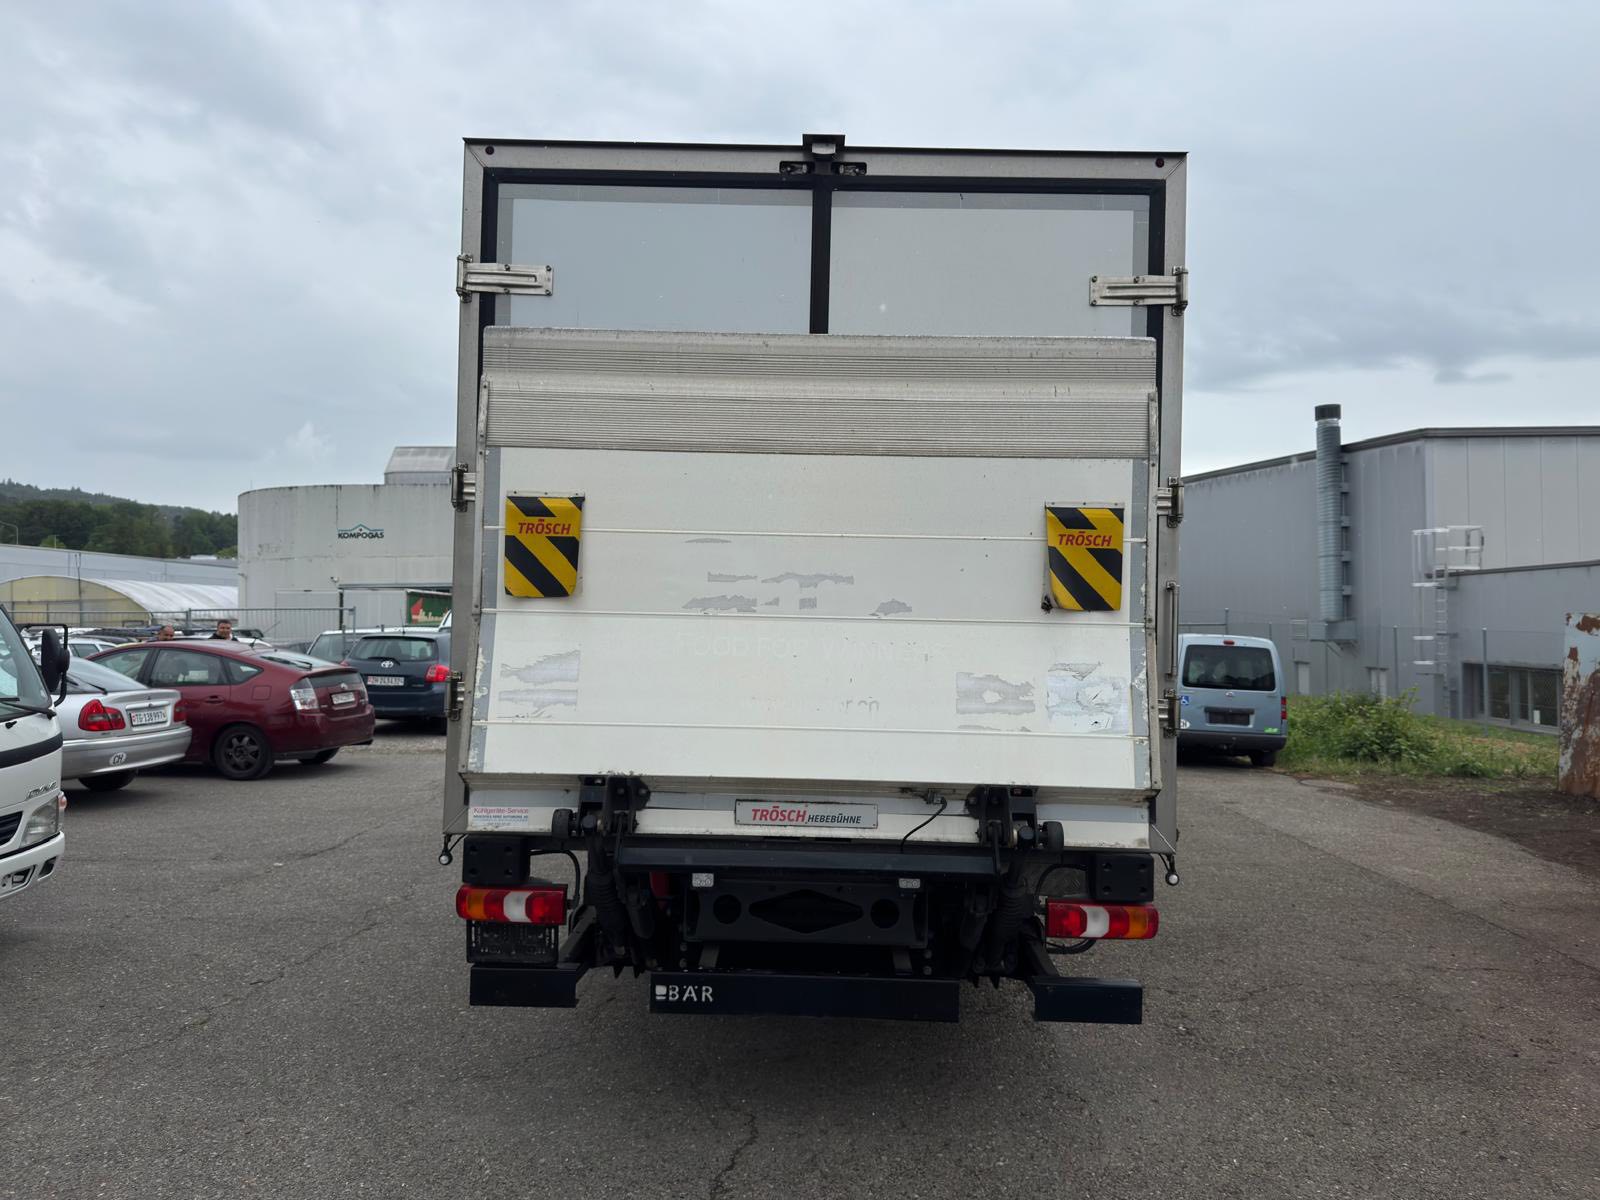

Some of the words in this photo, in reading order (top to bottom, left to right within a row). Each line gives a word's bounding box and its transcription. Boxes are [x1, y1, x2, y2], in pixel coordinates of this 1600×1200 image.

[518, 519, 571, 534] TRÖSCH
[1058, 531, 1112, 547] TRÖSCH
[752, 806, 807, 823] TRÖSCH
[807, 813, 862, 824] HEBEBÜHNE
[668, 985, 713, 1003] BÄR
